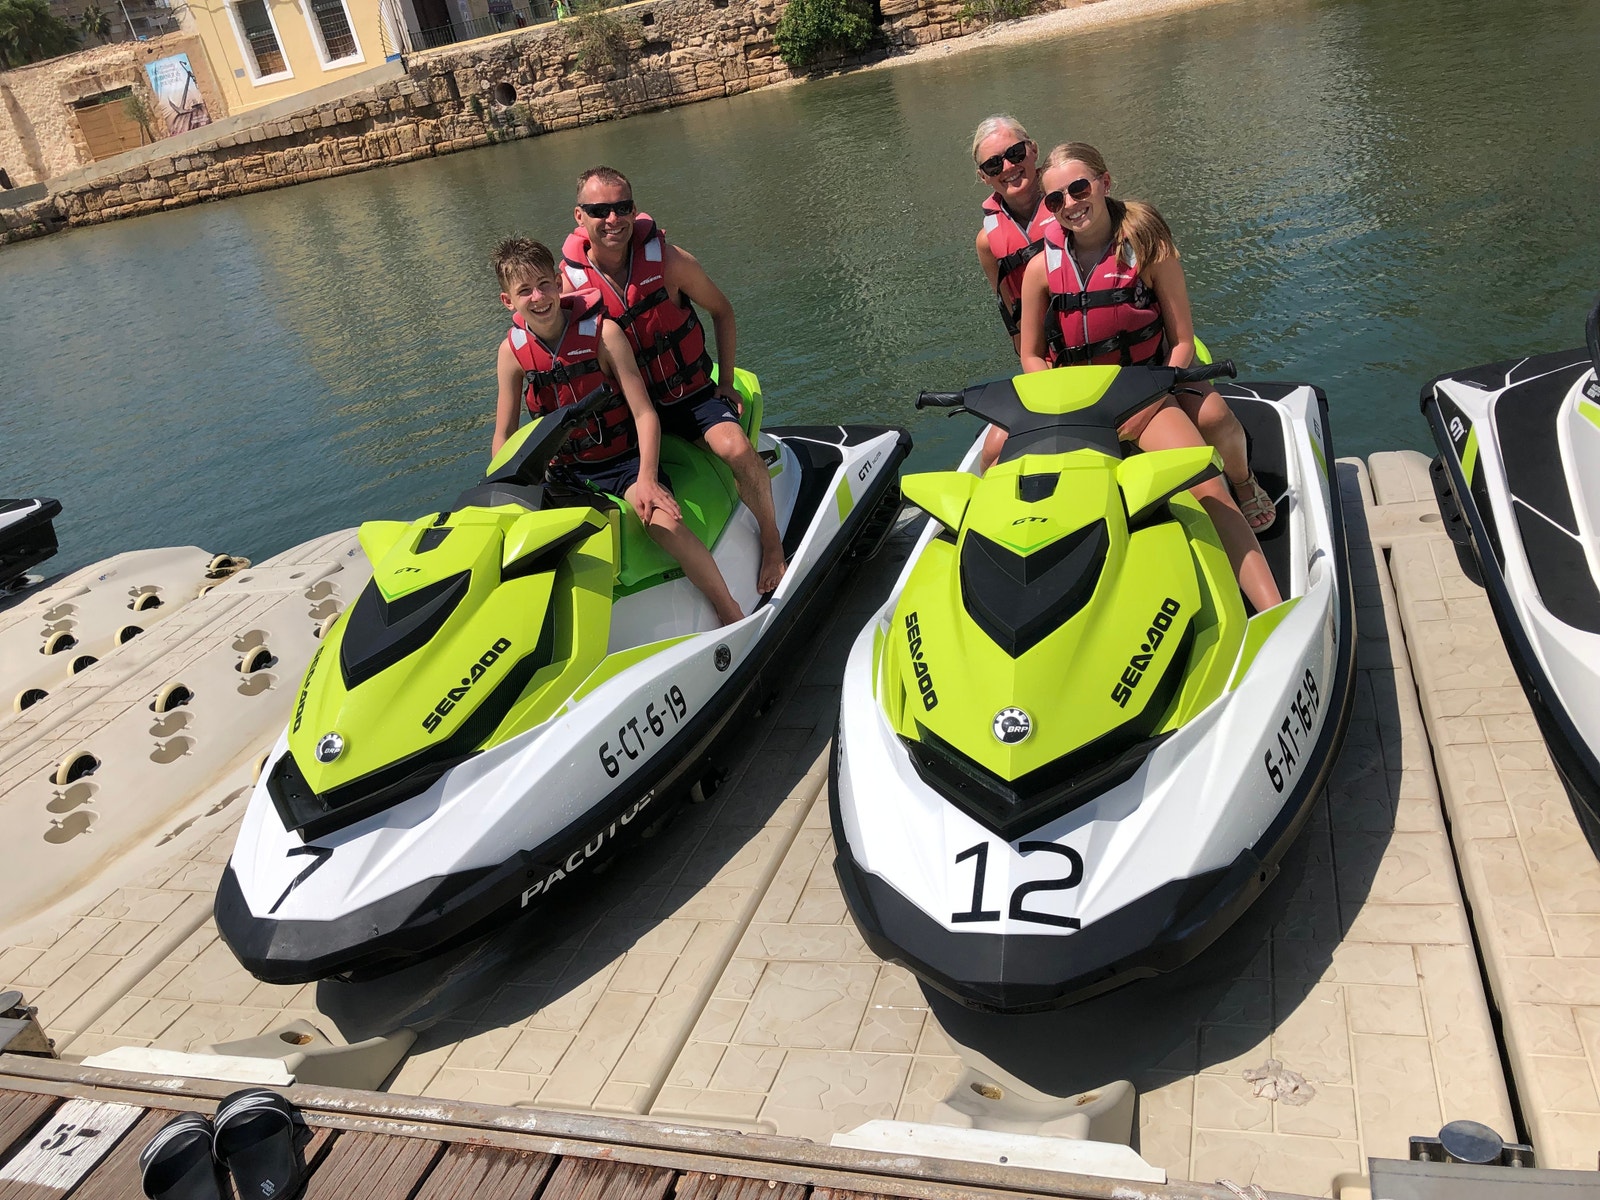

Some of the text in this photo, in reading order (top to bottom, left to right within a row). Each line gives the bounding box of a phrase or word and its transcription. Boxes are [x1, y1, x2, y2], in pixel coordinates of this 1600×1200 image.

[857, 460, 873, 482] GTI
[1012, 516, 1049, 526] GTI
[598, 684, 688, 779] 6-CT-6-19
[1006, 725, 1029, 733] BRP
[268, 845, 335, 914] 7
[950, 840, 1085, 930] 12
[40, 1123, 102, 1157] 57
